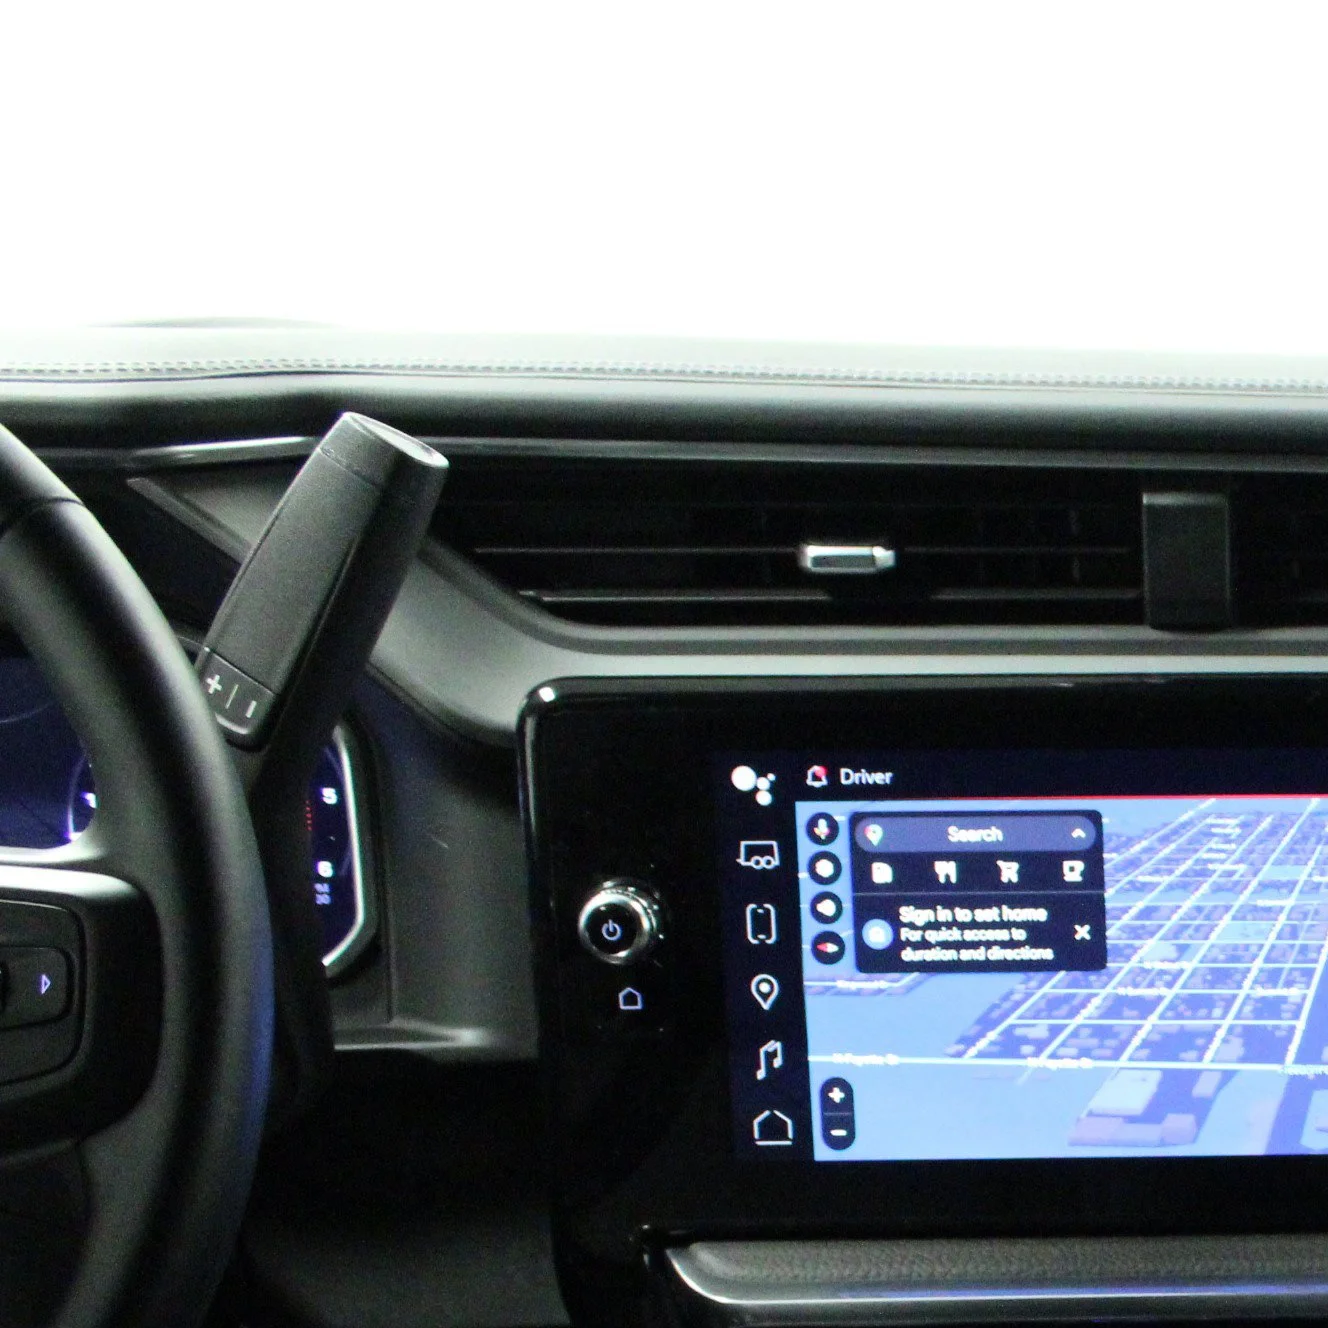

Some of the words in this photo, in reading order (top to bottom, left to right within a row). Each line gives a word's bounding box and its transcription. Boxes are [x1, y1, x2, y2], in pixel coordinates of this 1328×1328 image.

[840, 767, 893, 785] Driver
[322, 787, 338, 805] 5
[947, 825, 1004, 842] Search
[899, 905, 935, 925] Sign
[936, 905, 952, 922] in
[953, 906, 973, 922] to
[974, 906, 1000, 922] set
[1001, 905, 1048, 922] home
[899, 927, 923, 942] For
[924, 926, 963, 943] quick
[964, 928, 1010, 942] access
[1011, 927, 1027, 941] to
[901, 947, 957, 962] duration
[959, 946, 986, 961] and
[986, 946, 1054, 961] directions
